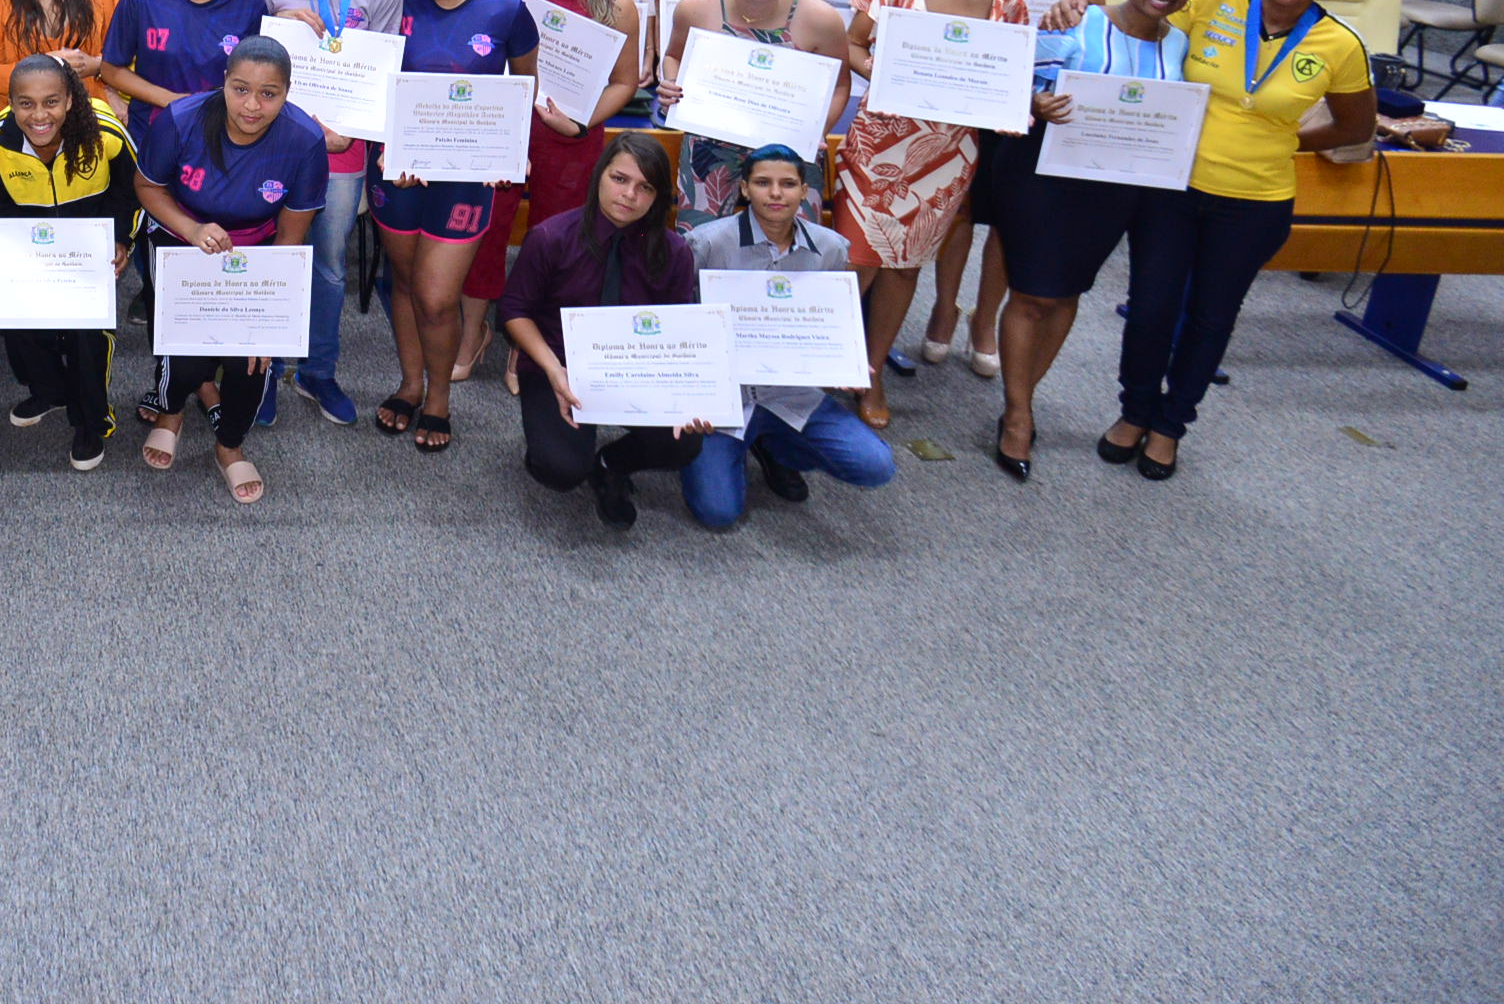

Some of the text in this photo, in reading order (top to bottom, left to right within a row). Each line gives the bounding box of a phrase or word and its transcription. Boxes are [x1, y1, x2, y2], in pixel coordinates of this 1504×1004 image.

[147, 28, 169, 52] 07
[290, 54, 307, 62] loma
[447, 203, 482, 233] 91
[181, 280, 211, 288] Diploma
[731, 304, 757, 313] iploma
[593, 343, 624, 351] Diploma
